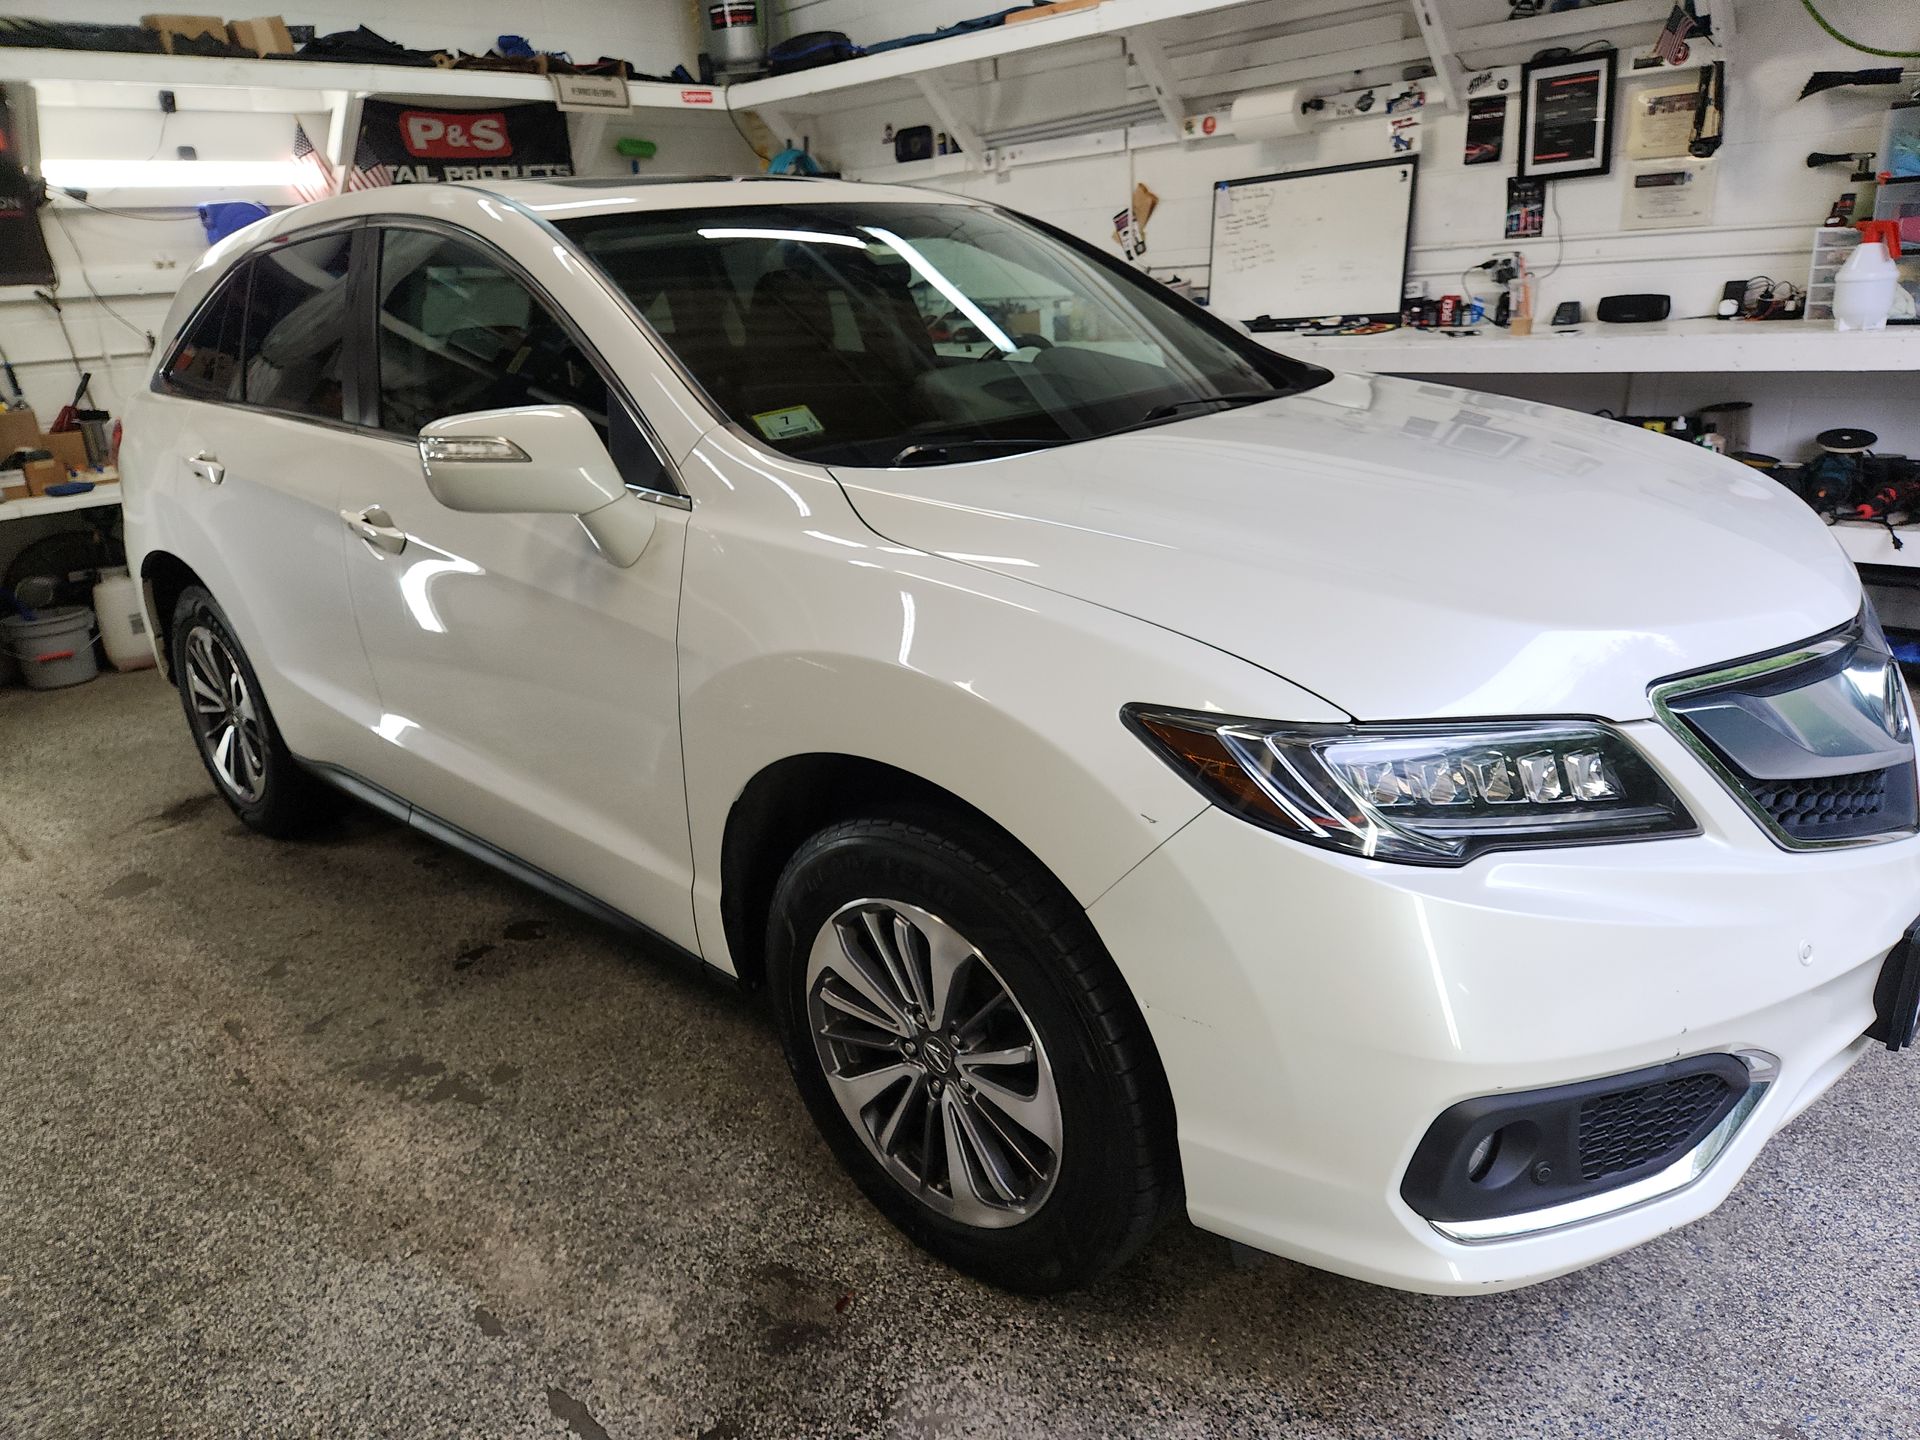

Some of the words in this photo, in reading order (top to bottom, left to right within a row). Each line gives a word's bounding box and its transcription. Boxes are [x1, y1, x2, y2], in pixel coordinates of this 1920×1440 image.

[406, 117, 505, 151] P&S
[385, 164, 439, 183] TAIL
[444, 164, 572, 181] PRODUCTS
[779, 416, 789, 425] 7
